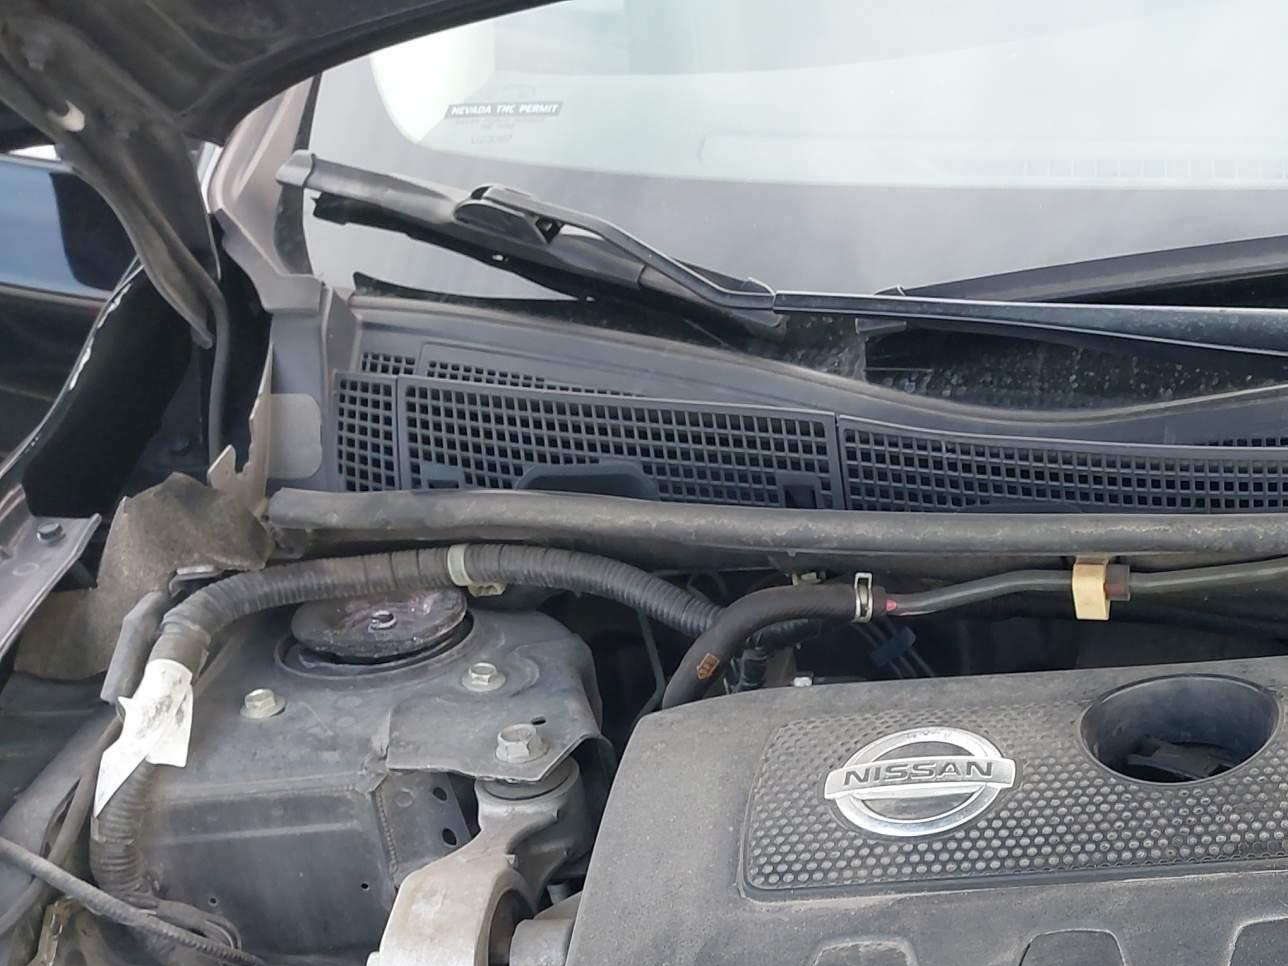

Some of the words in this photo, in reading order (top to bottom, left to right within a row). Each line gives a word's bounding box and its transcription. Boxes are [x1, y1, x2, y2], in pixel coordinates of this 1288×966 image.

[450, 104, 492, 115] NEVADA
[518, 103, 560, 113] PERMIT
[843, 761, 993, 786] NISSAN
